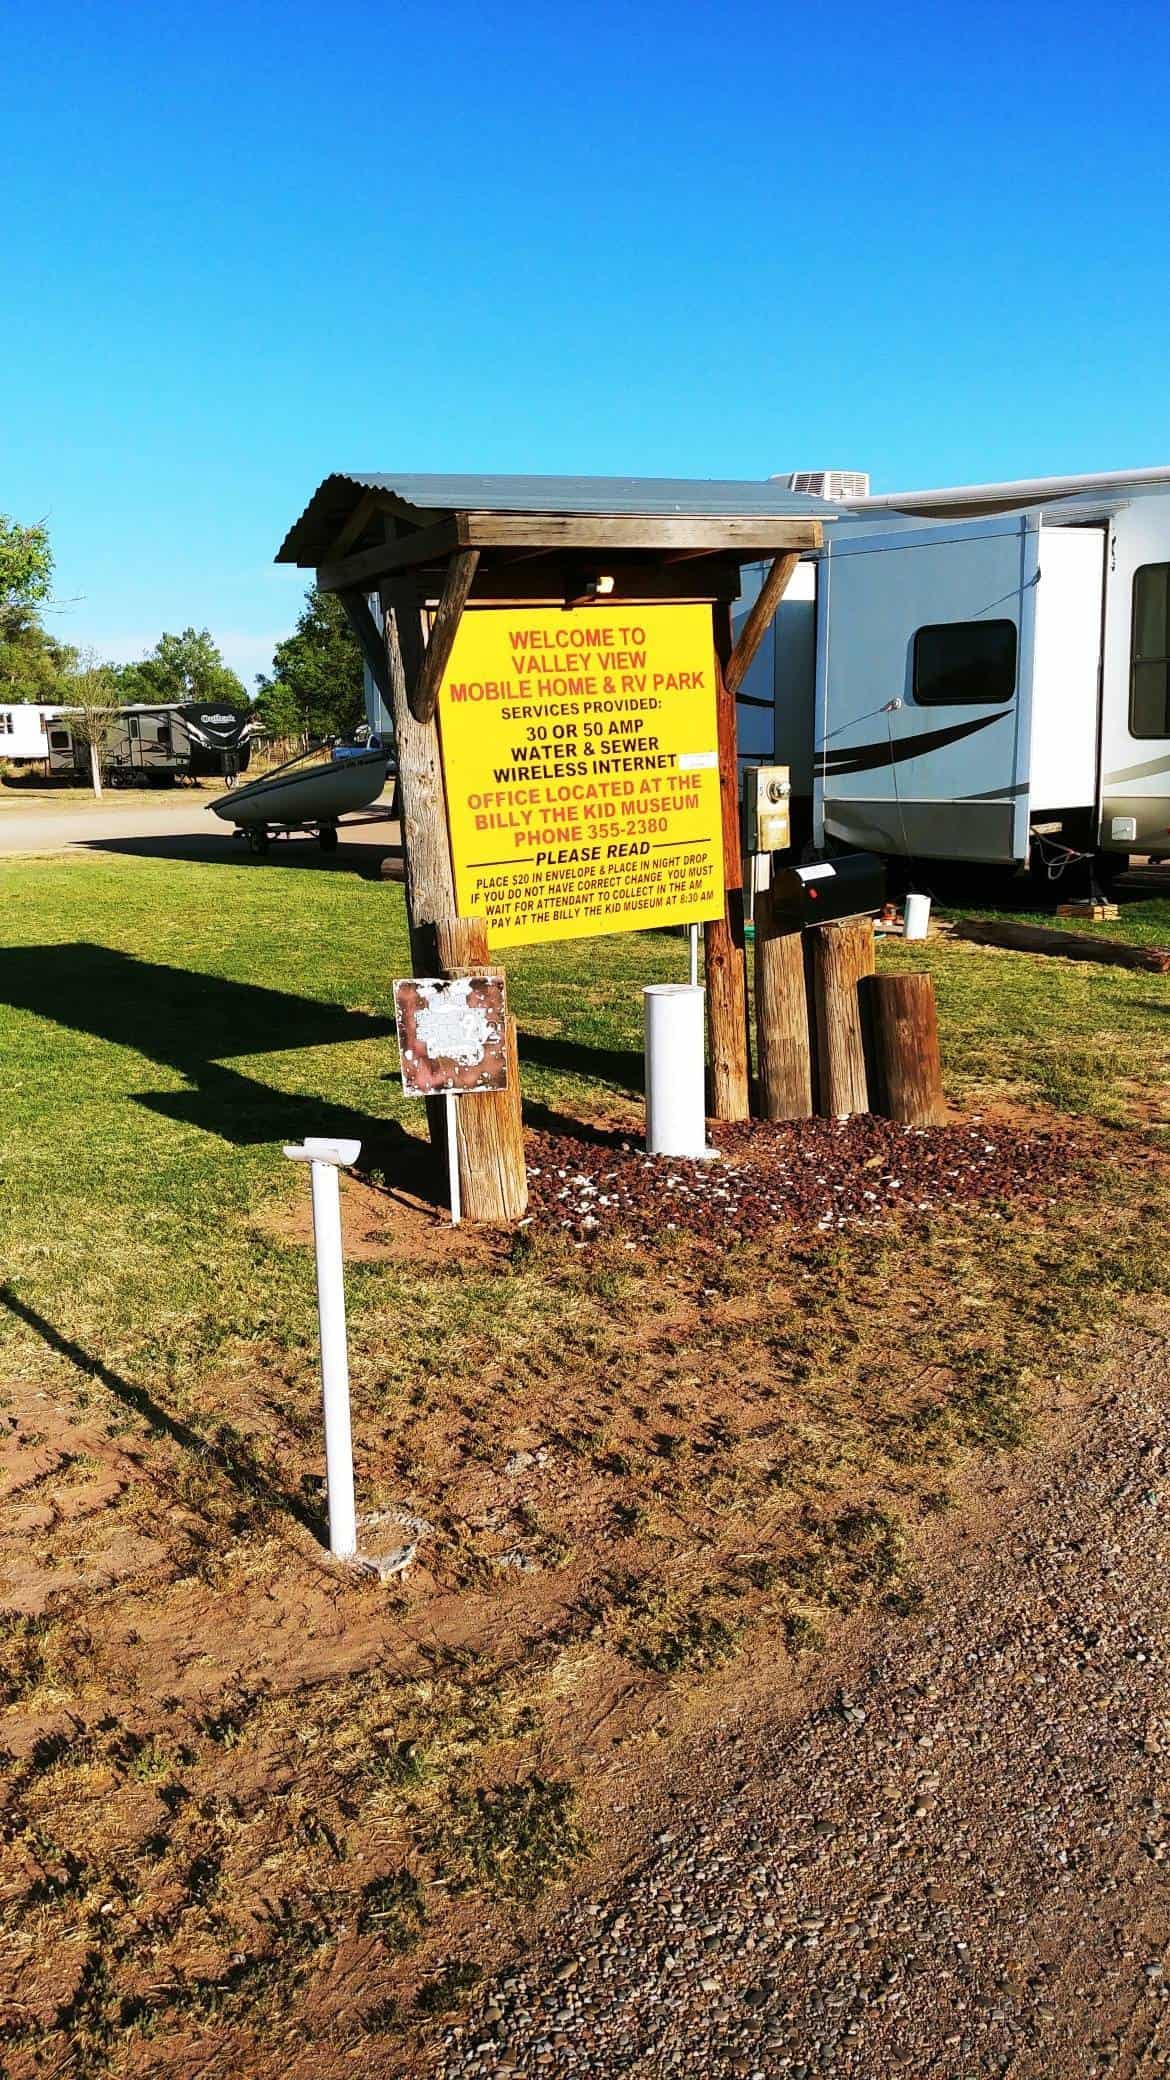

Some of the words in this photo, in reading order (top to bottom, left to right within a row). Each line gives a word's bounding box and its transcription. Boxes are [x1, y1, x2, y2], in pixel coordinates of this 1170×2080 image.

[509, 628, 615, 650] WELCOME
[618, 627, 646, 646] TO
[511, 653, 591, 674] VALLEY
[598, 651, 647, 671] VIEW
[450, 680, 532, 702] MOBILE
[538, 677, 598, 698] HOME
[602, 676, 616, 694] &
[621, 674, 647, 693] RV
[653, 672, 705, 691] PARK
[501, 703, 579, 720] SERVICES
[583, 697, 662, 714] PROVIDED:
[526, 726, 547, 741] 30
[552, 724, 578, 739] OR
[583, 721, 603, 737] 50
[608, 719, 644, 735] AMP
[511, 743, 577, 762] WATER
[583, 741, 595, 756] &
[600, 737, 659, 755] SEWER
[493, 762, 588, 783] WIRELESS
[593, 754, 677, 774] INTERNET
[467, 788, 541, 810] OFFICE
[546, 780, 634, 803] LOCATED
[640, 777, 662, 794] AT
[666, 774, 702, 791] THE
[475, 810, 532, 831] BILLY
[539, 806, 579, 823] THE
[583, 802, 616, 820] KID
[621, 794, 699, 816] MUSEUM
[514, 826, 583, 848] PHONE
[587, 817, 668, 840] 355-2380
[536, 846, 601, 866] PLEASE
[607, 841, 650, 858] READ
[471, 893, 480, 904] IF
[484, 890, 505, 902] YOU
[508, 888, 521, 900] DO
[524, 885, 545, 897] NOT
[548, 882, 574, 894] HAVE
[577, 876, 622, 891] CORRECT
[624, 871, 662, 885] CHANGE
[667, 868, 686, 880] YOU
[688, 865, 714, 877] MUST
[476, 876, 509, 889] PLACE
[512, 873, 530, 886] $20
[532, 871, 543, 883] IN
[545, 866, 596, 881] ENVELOPE
[599, 865, 606, 875] &
[608, 861, 637, 874] PLACE
[640, 859, 650, 870] IN
[652, 856, 680, 869] NIGHT
[683, 853, 708, 865] DROP
[486, 903, 511, 916] WAIT
[514, 900, 534, 912] FOR
[537, 893, 594, 909] ATTENDANT
[598, 891, 610, 901] TO
[612, 885, 654, 900] COLLECT
[656, 884, 666, 894] IN
[669, 881, 686, 892] THE
[689, 879, 703, 889] AM
[491, 917, 511, 928] PAY
[514, 915, 527, 926] AT
[531, 912, 550, 923] THE
[553, 908, 580, 920] BILLY
[584, 905, 602, 916] THE
[605, 902, 621, 913] KID
[623, 898, 663, 911] MUSEUM
[666, 895, 677, 905] AT
[701, 890, 715, 900] AM
